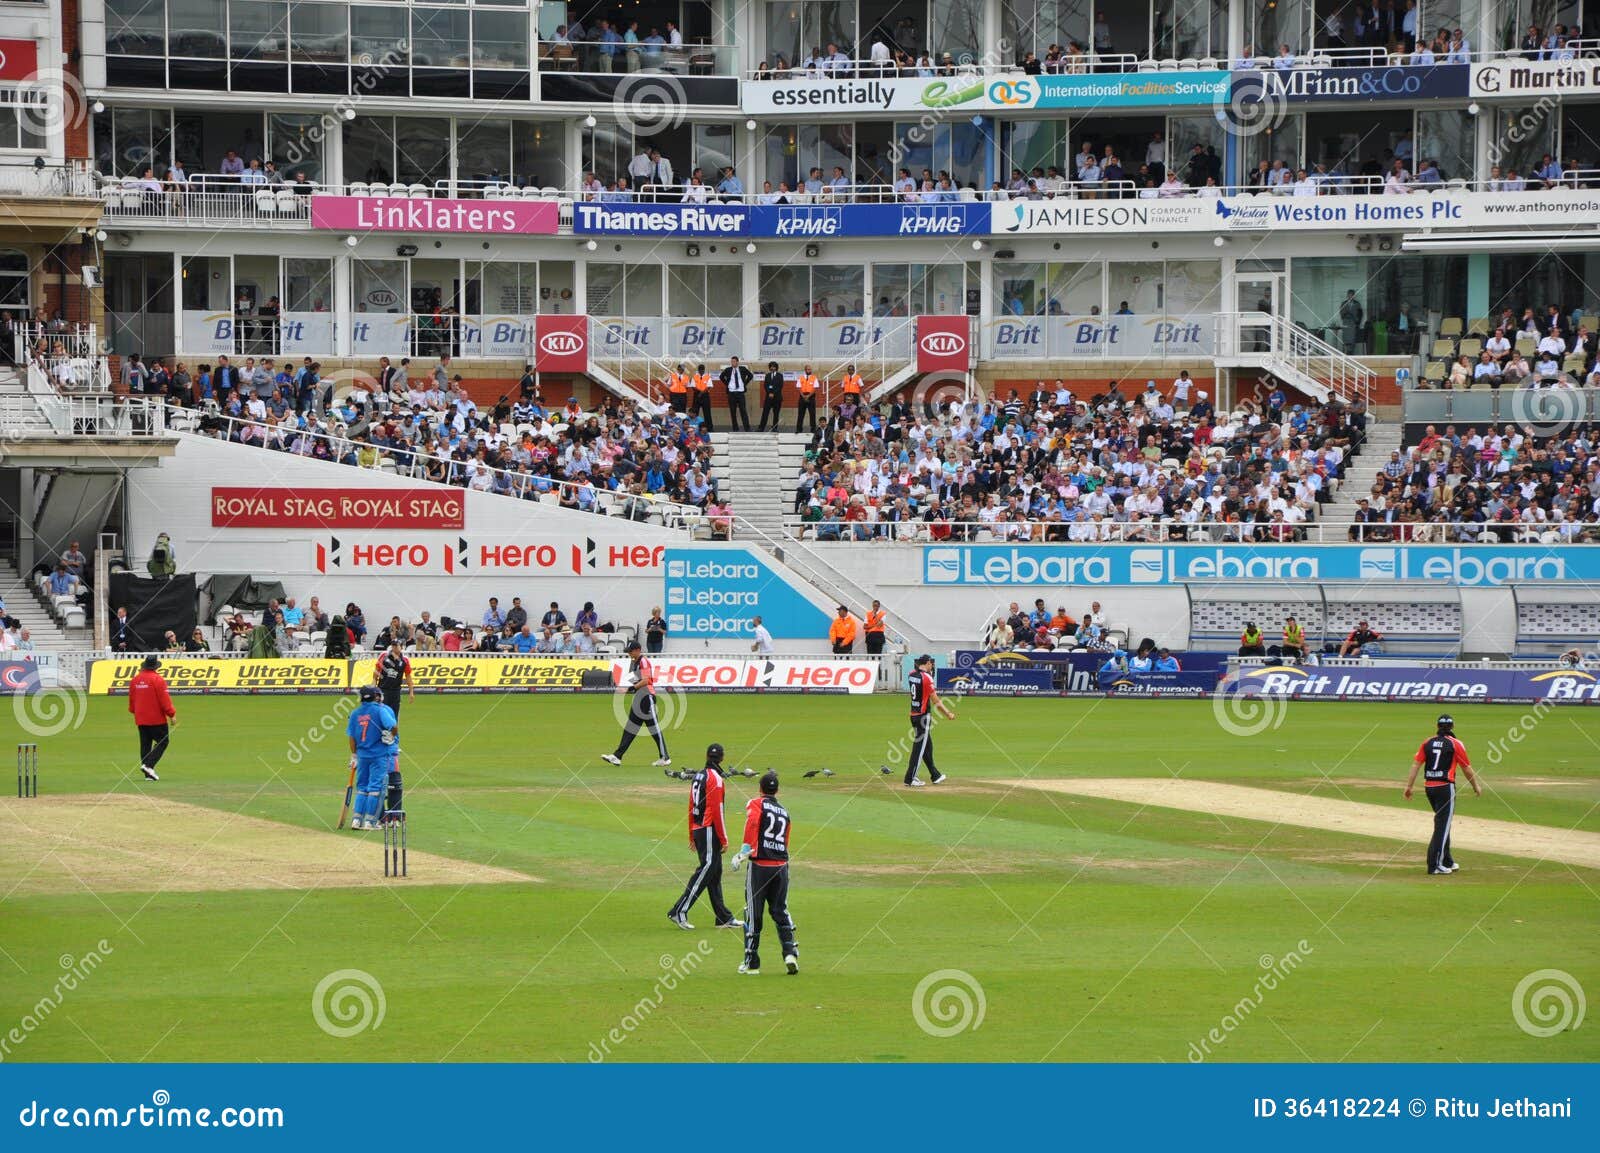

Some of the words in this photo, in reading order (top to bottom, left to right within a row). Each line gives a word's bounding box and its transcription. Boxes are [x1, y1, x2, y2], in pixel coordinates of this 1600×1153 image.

[1510, 66, 1586, 89] Martin
[772, 81, 895, 109] essentially
[357, 199, 516, 231] Linklaters
[579, 206, 678, 231] Thames
[681, 208, 745, 232] River
[1026, 207, 1148, 230] JAMIESON
[1150, 207, 1202, 215] CORPORATE
[1150, 216, 1190, 224] FINANCE
[1275, 204, 1347, 222] Weston
[1355, 202, 1424, 221] Homes
[1432, 199, 1462, 219] Plc
[776, 218, 838, 235] KPMG
[900, 216, 961, 233] KPMG
[372, 294, 392, 304] KIA
[605, 324, 651, 345] Brit
[682, 325, 726, 346] Brit
[762, 326, 805, 346] Brit
[839, 325, 883, 346] Brit
[997, 324, 1041, 344] Brit
[1076, 324, 1119, 344] Brit
[1154, 323, 1201, 343] Brit
[548, 337, 577, 350] KIA
[929, 336, 958, 351] KIA
[216, 498, 277, 517] ROYAL
[283, 499, 334, 518] STAG
[342, 499, 404, 518] ROYAL
[409, 500, 459, 518] STAG
[686, 560, 759, 579] Lebara
[965, 548, 1110, 584] Lebara
[1169, 548, 1319, 578] Lebara
[1401, 548, 1566, 582] Lebara
[686, 587, 759, 606] Lebara
[238, 664, 341, 678] UltraTech
[1261, 673, 1331, 695] Brit
[1336, 674, 1488, 698] Insurance
[359, 720, 369, 742] 7
[1432, 749, 1442, 770] 7
[764, 812, 787, 843] 22
